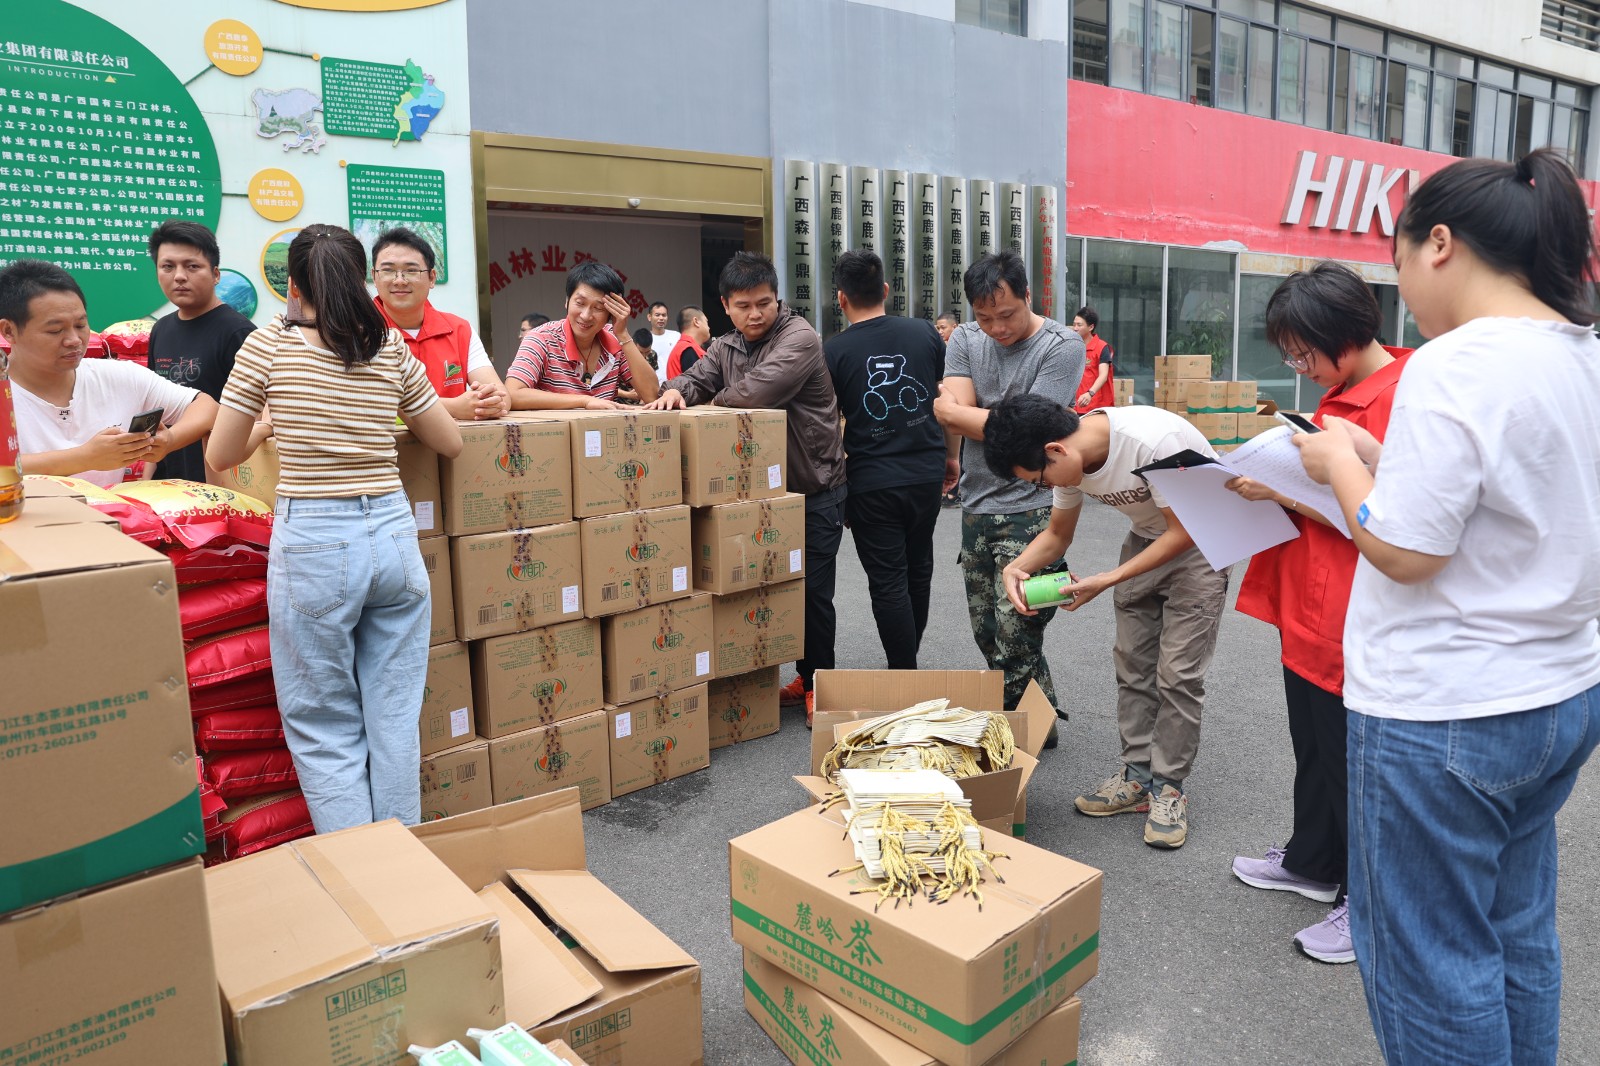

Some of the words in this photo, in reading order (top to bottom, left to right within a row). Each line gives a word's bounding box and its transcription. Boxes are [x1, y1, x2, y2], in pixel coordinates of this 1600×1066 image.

[0, 41, 129, 70] 集团有限责任公司
[212, 51, 257, 63] 有限责任公司
[8, 64, 99, 81] INTRODUCTION
[0, 104, 188, 129] 县政府下属祥鹿投资有限责任公
[0, 120, 194, 144] 立于2020年10月14日，注册资本5
[255, 198, 299, 208] 有限责任公司
[979, 190, 991, 257] 广西鹿
[892, 180, 906, 317] 广西沃森有机肥
[922, 184, 934, 322] 广西鹿泰旅游开发
[793, 901, 883, 967] 麓岭茶
[782, 984, 842, 1060] 麓岭茶
